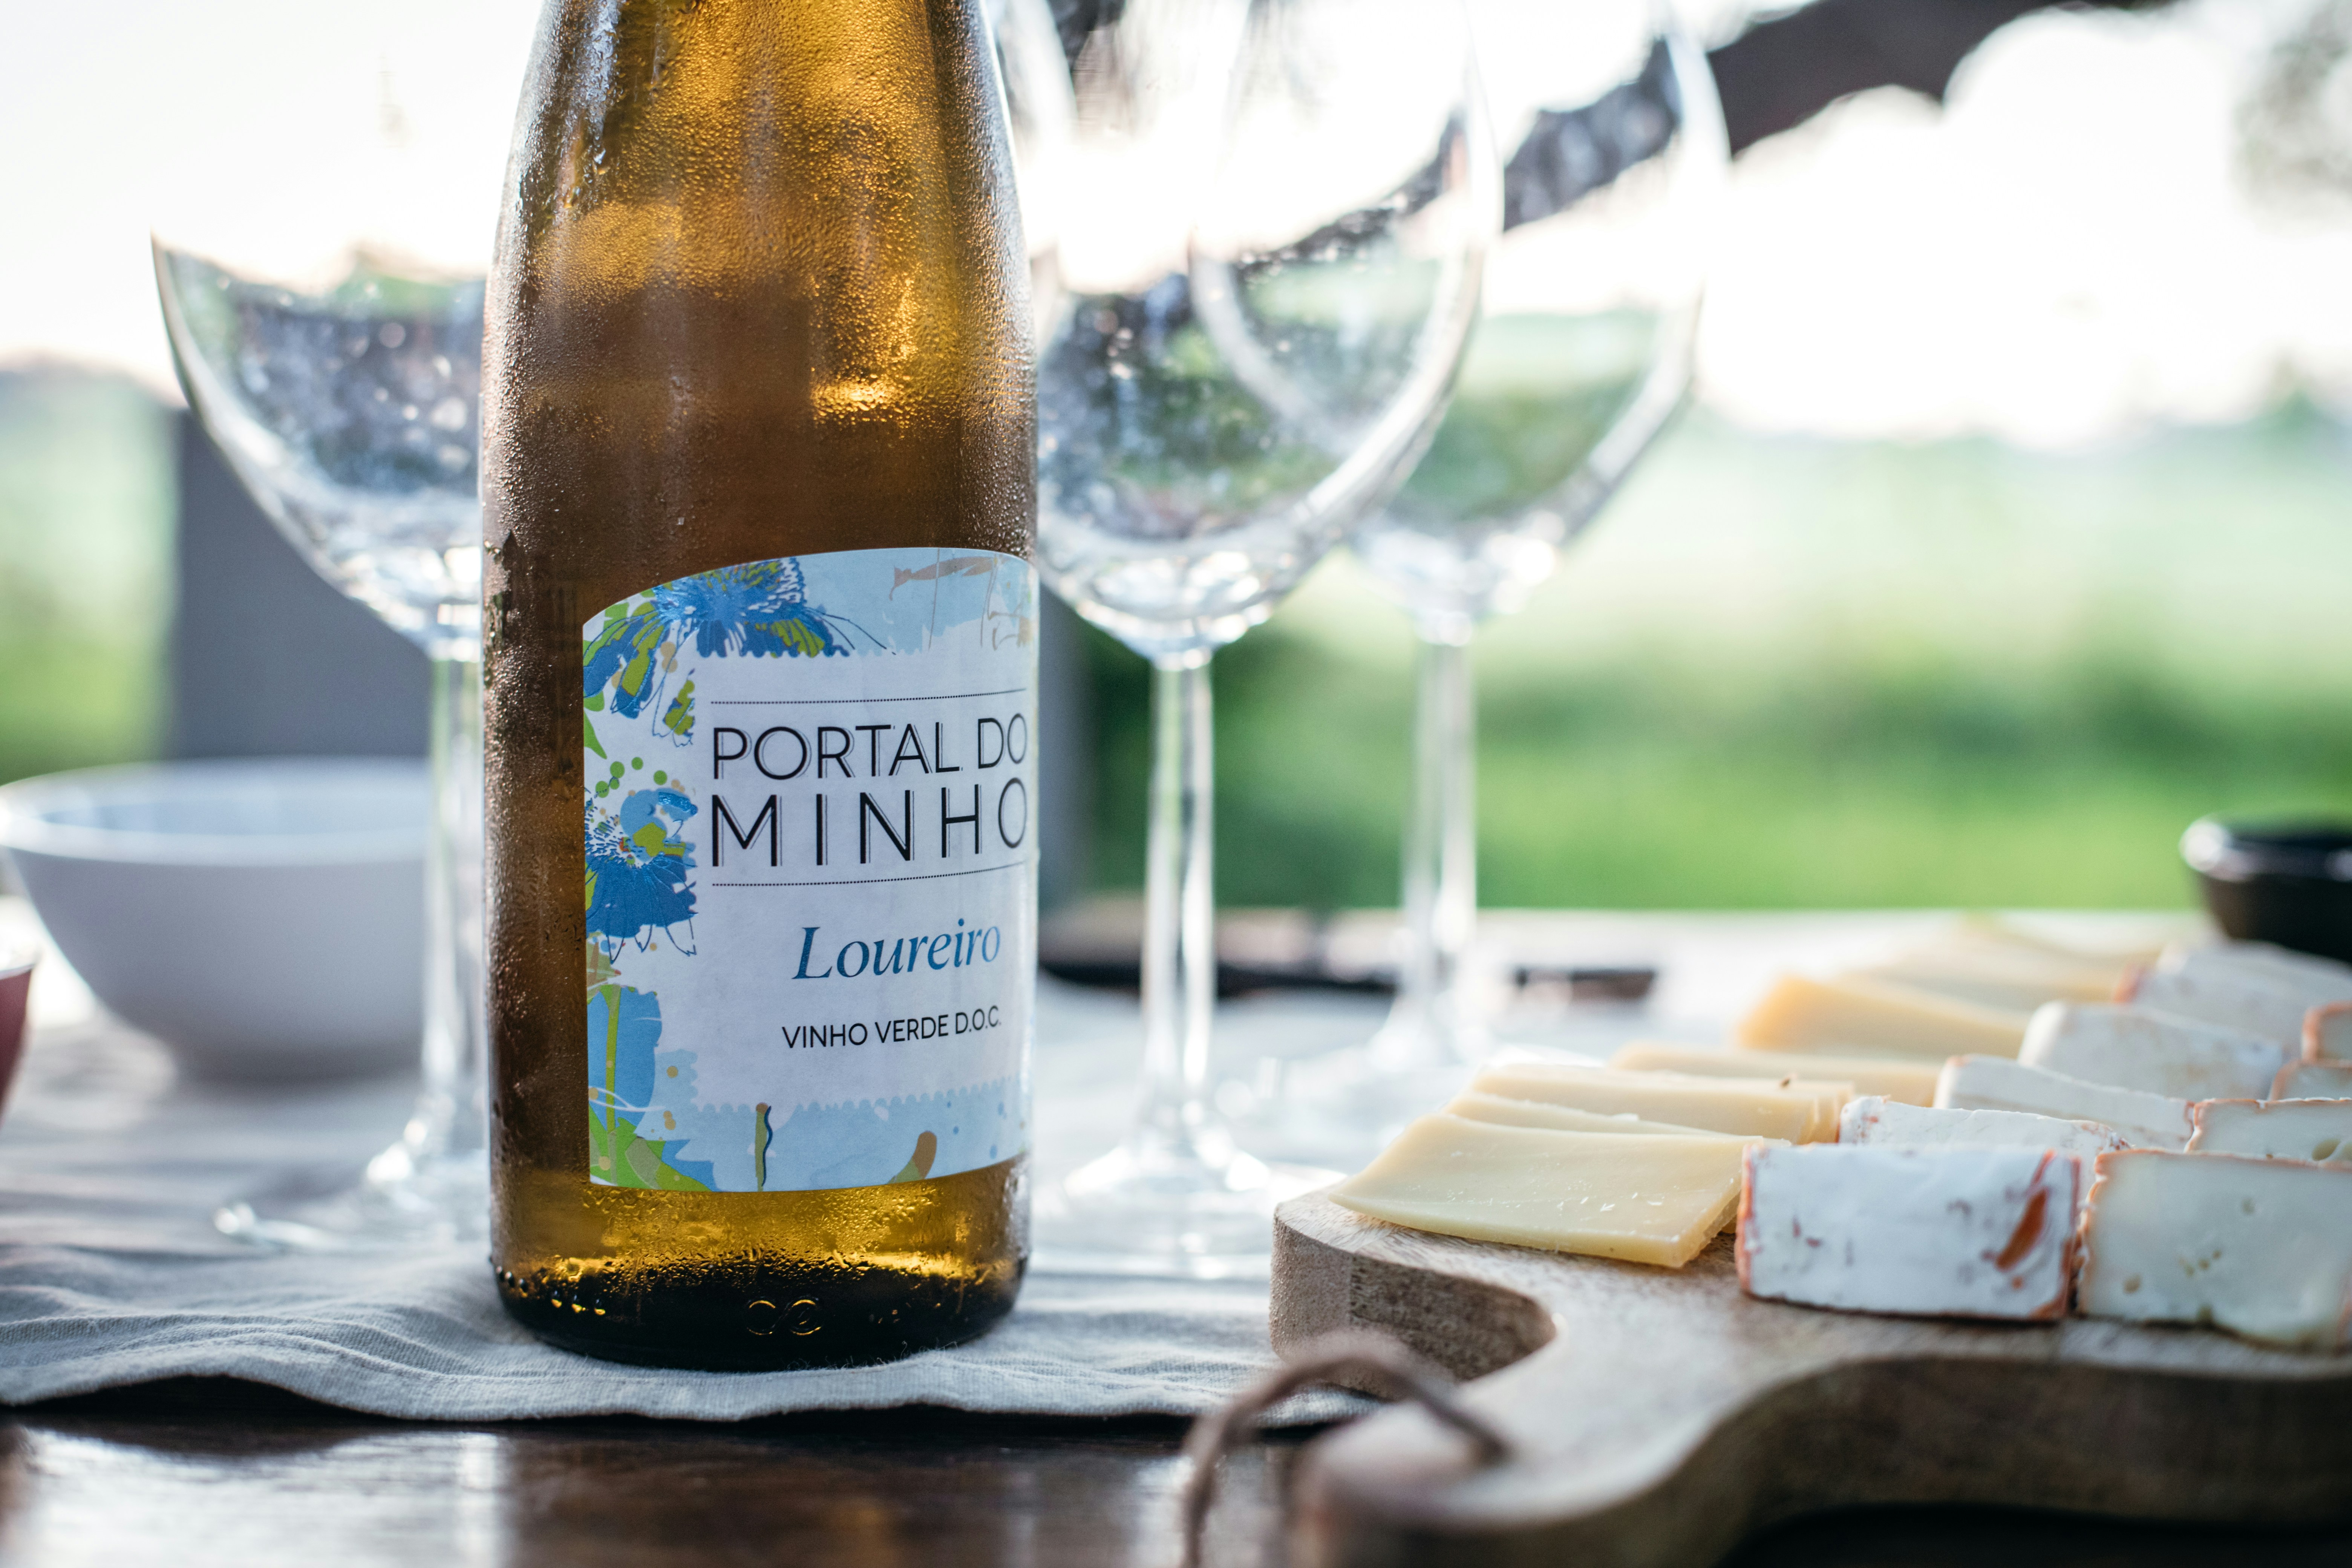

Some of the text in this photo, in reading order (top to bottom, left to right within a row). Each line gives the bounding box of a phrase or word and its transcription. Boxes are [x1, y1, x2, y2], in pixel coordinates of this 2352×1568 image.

[713, 713, 1028, 780] PORTAL DO
[712, 777, 1028, 867] MINHO
[792, 918, 1001, 980] Loureiro
[782, 1005, 1002, 1049] VINHO VERDE D.O.C.
